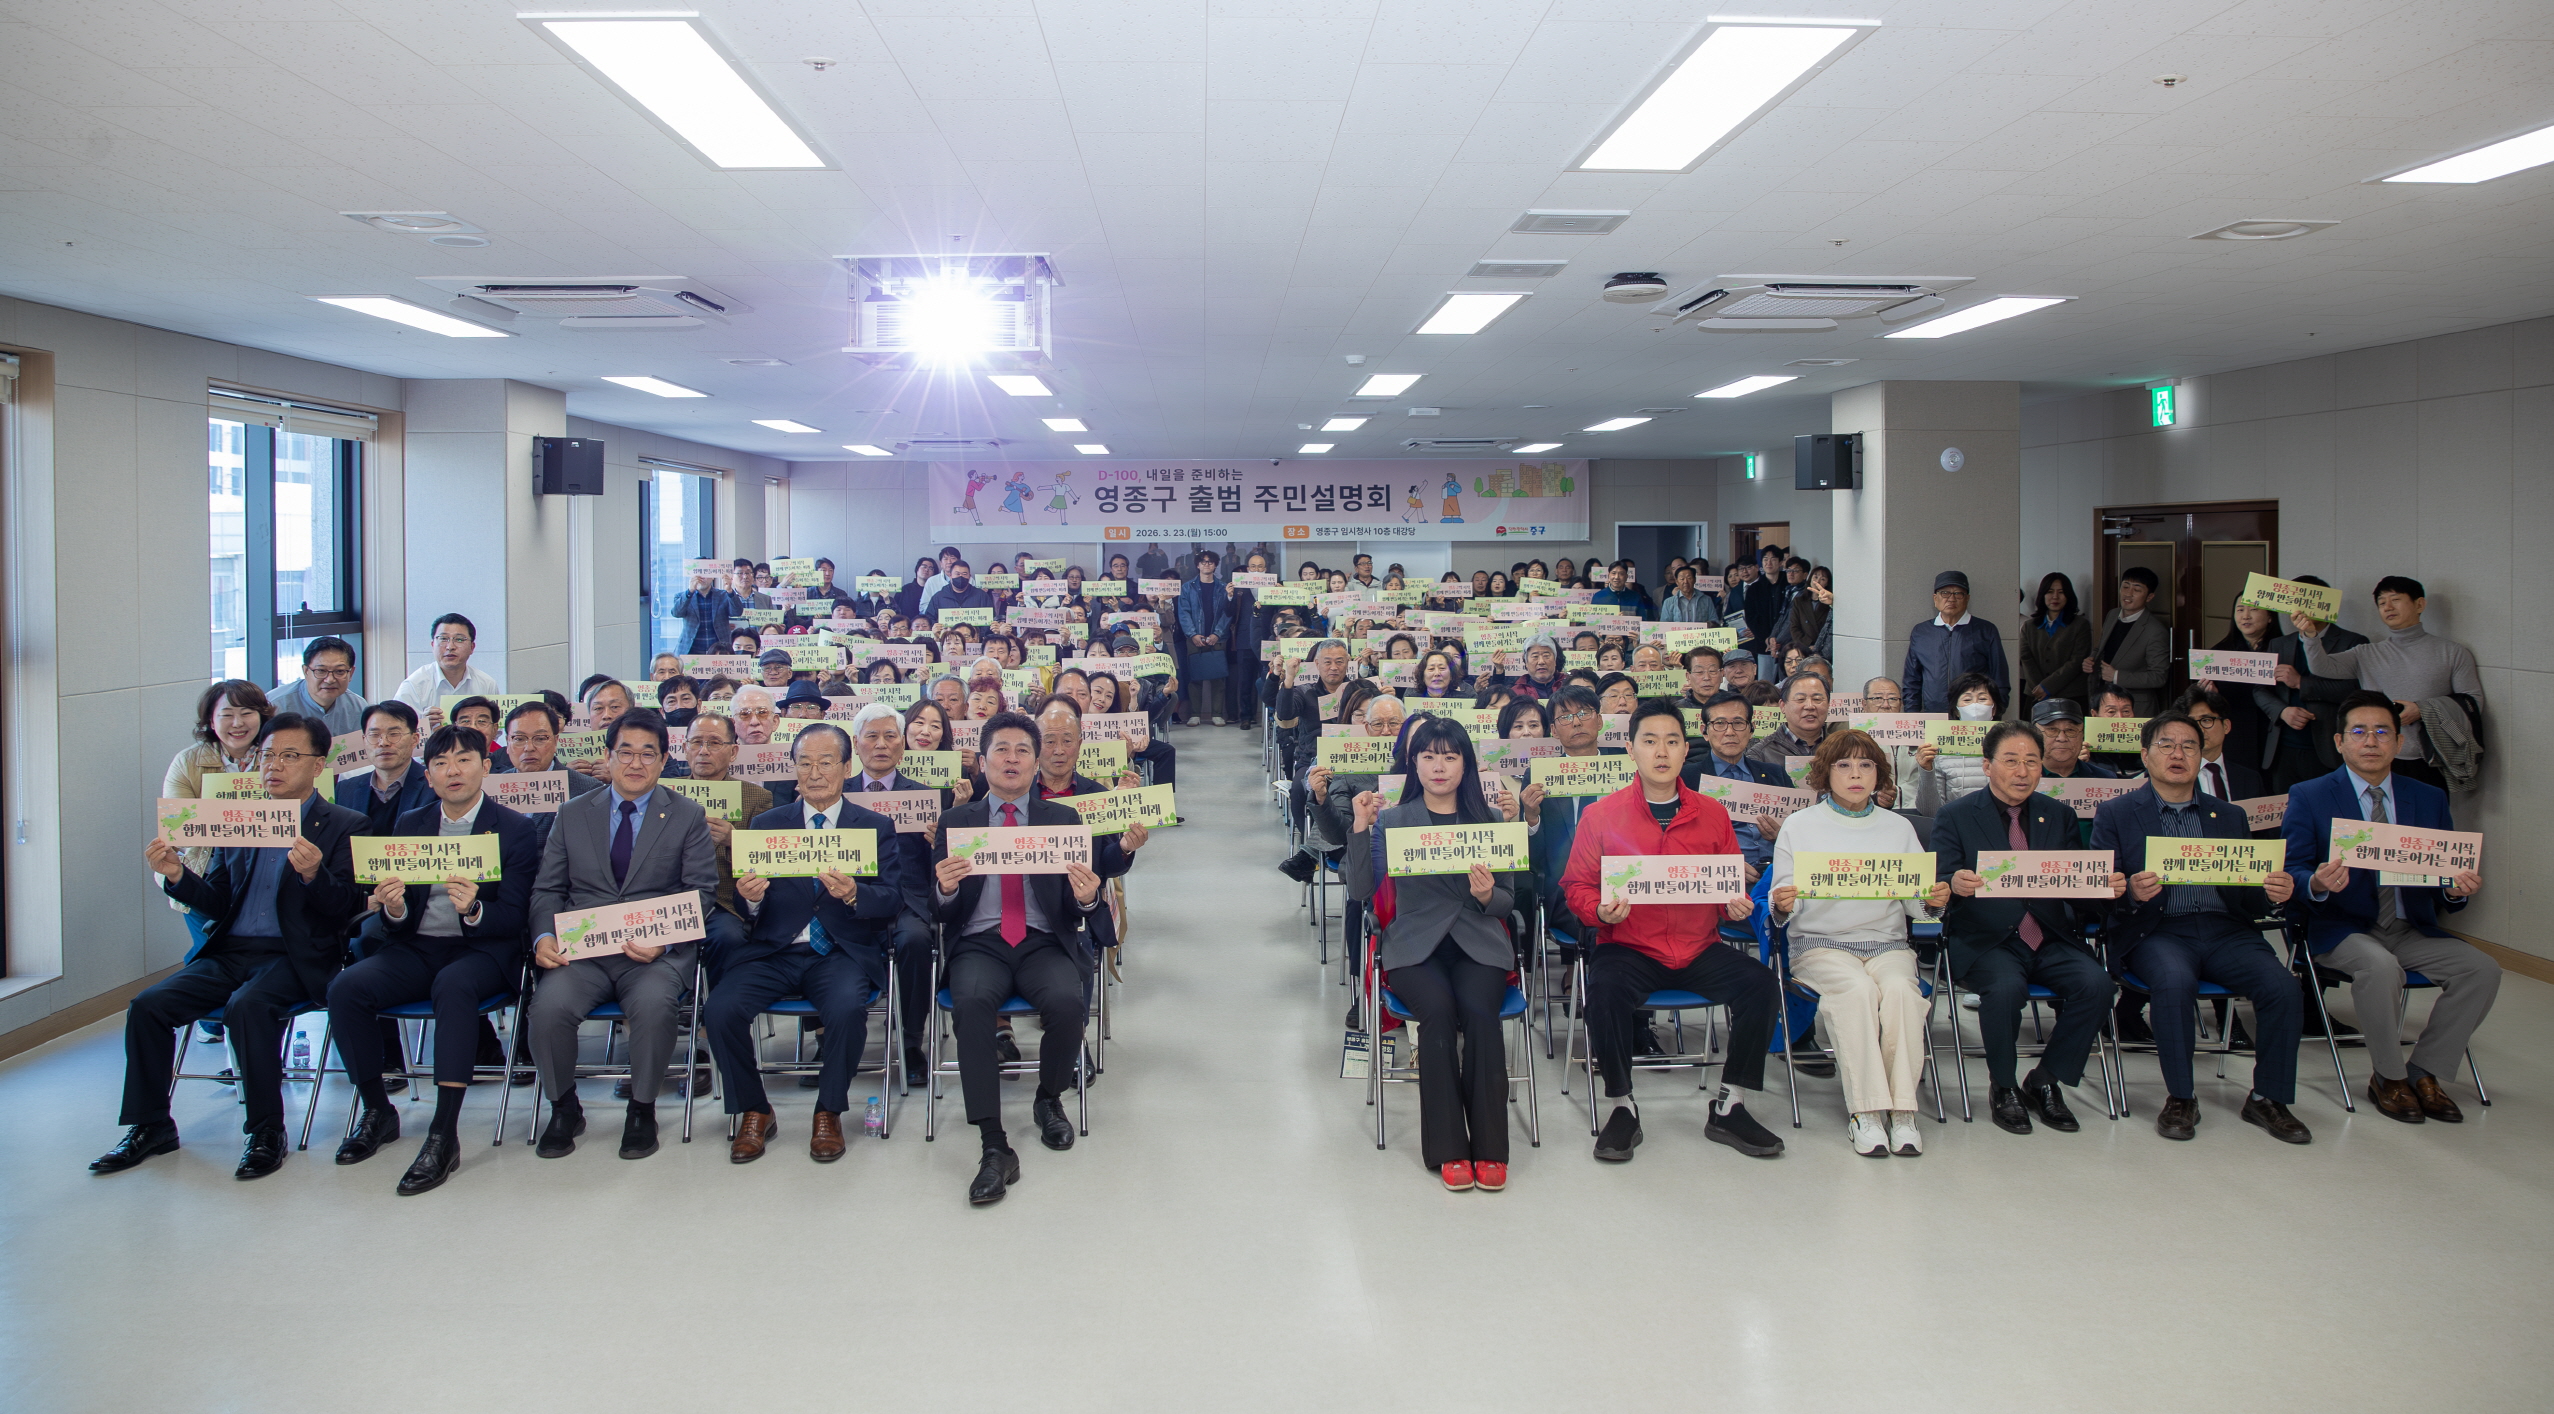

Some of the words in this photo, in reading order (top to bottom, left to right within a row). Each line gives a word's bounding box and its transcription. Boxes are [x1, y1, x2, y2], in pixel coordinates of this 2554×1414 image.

[1099, 470, 1142, 483] D-100,
[1146, 468, 1185, 482] 내일을
[1190, 468, 1243, 482] 준비하는
[1094, 485, 1177, 513] 영종구
[1188, 484, 1241, 512] 출범
[1253, 484, 1391, 512] 주민설명회
[1136, 528, 1158, 537] 2026.
[1161, 528, 1170, 537] 3.
[1172, 528, 1201, 538] 23.(월)
[1203, 528, 1228, 537] 15:00
[1316, 527, 1339, 537] 영종구
[1340, 527, 1372, 537] 임시청사
[1373, 527, 1391, 537] 10층
[1392, 527, 1416, 537] 대강당
[1530, 526, 1546, 536] 중구
[2273, 583, 2306, 597] 영종구의
[2308, 588, 2322, 600] 시작
[2257, 590, 2274, 601] 함께
[2276, 594, 2316, 609] 만들어가는
[2317, 602, 2331, 611] 미래
[2229, 657, 2256, 667] 영종구의
[2258, 659, 2274, 669] 시작,
[691, 666, 703, 674] 함께
[2204, 664, 2219, 674] 함께
[2221, 666, 2256, 677] 만들어가는
[2258, 669, 2273, 679] 미래
[860, 687, 886, 695] 영종구의
[502, 699, 518, 708] 시작
[898, 694, 912, 702] 미래
[1422, 701, 1448, 709] 영종구의
[1895, 720, 1925, 729] 영종구의
[1951, 725, 1987, 736] 영종구의
[774, 732, 790, 741] 함께
[1605, 732, 1621, 740] 함께
[1937, 736, 1954, 746] 함께
[2098, 733, 2115, 743] 함께
[1082, 748, 1100, 758] 시작
[1344, 742, 1379, 752] 영종구의
[1530, 746, 1563, 756] 영종구의
[336, 753, 359, 766] 함께
[916, 756, 934, 766] 시작
[1097, 758, 1115, 768] 미래
[1330, 753, 1347, 763] 함께
[1500, 758, 1517, 768] 함께
[747, 763, 794, 775] 만들어가는
[930, 768, 949, 778] 미래
[1560, 761, 1599, 773] 영종구의
[1602, 761, 1622, 771] 시작
[499, 780, 536, 793] 영종구의
[542, 779, 565, 792] 시작,
[1545, 776, 1564, 786] 함께
[1567, 774, 1616, 785] 만들어가는
[544, 792, 565, 804] 미래
[690, 786, 710, 797] 시작
[2086, 788, 2123, 798] 영종구의
[707, 798, 727, 810] 미래
[1077, 798, 1118, 813] 영종구의
[1122, 793, 1142, 805] 시작
[1753, 792, 1790, 806] 영종구의
[872, 801, 911, 812] 영종구의
[915, 800, 937, 811] 시작,
[1740, 802, 1788, 818] 만들어가는
[222, 809, 266, 822] 영종구의
[270, 810, 296, 823] 시작,
[917, 812, 937, 823] 미래
[1086, 809, 1138, 824] 만들어가는
[1140, 804, 1161, 816] 미래
[181, 822, 206, 837] 함께
[209, 824, 269, 838] 만들어가는
[272, 824, 295, 839] 미래
[765, 835, 813, 850] 영종구의
[817, 834, 842, 848] 시작
[1014, 836, 1058, 849] 영종구의
[1062, 835, 1088, 849] 시작,
[1419, 830, 1467, 846] 영종구의
[1471, 829, 1495, 844] 시작
[383, 842, 433, 857] 영종구의
[436, 842, 462, 856] 시작
[1402, 847, 1426, 862] 함께
[1429, 844, 1488, 861] 만들어가는
[1490, 843, 1514, 858] 미래
[2180, 843, 2228, 858] 영종구의
[2230, 844, 2256, 858] 시작
[2400, 836, 2448, 852] 영종구의
[2450, 842, 2477, 856] 시작,
[747, 850, 771, 864] 함께
[774, 849, 834, 864] 만들어가는
[837, 848, 861, 863] 미래
[973, 851, 997, 865] 함께
[1000, 850, 1060, 864] 만들어가는
[1063, 849, 1087, 864] 미래
[2353, 844, 2380, 860] 함께
[2384, 848, 2447, 867] 만들어가는
[2450, 856, 2475, 870] 미래
[366, 857, 391, 872] 함께
[393, 856, 455, 871] 만들어가는
[457, 856, 481, 870] 미래
[1828, 858, 1876, 873] 영종구의
[1879, 858, 1904, 872] 시작
[2040, 860, 2082, 873] 영종구의
[2085, 860, 2110, 873] 시작,
[2162, 857, 2185, 872] 함께
[2188, 858, 2246, 873] 만들어가는
[2248, 859, 2272, 873] 미래
[1667, 865, 1711, 878] 영종구의
[1715, 865, 1741, 878] 시작,
[1810, 872, 1833, 887] 함께
[1836, 872, 1894, 887] 만들어가는
[1897, 873, 1921, 887] 미래
[2000, 874, 2023, 888] 함께
[2026, 874, 2083, 888] 만들어가는
[2086, 874, 2109, 889] 미래
[1626, 880, 1650, 894] 함께
[1654, 880, 1713, 894] 만들어가는
[1716, 879, 1740, 894] 미래
[622, 906, 668, 925] 영종구의
[671, 902, 697, 917] 시작,
[581, 931, 608, 948] 함께
[610, 922, 671, 943] 만들어가는
[674, 915, 698, 933] 미래
